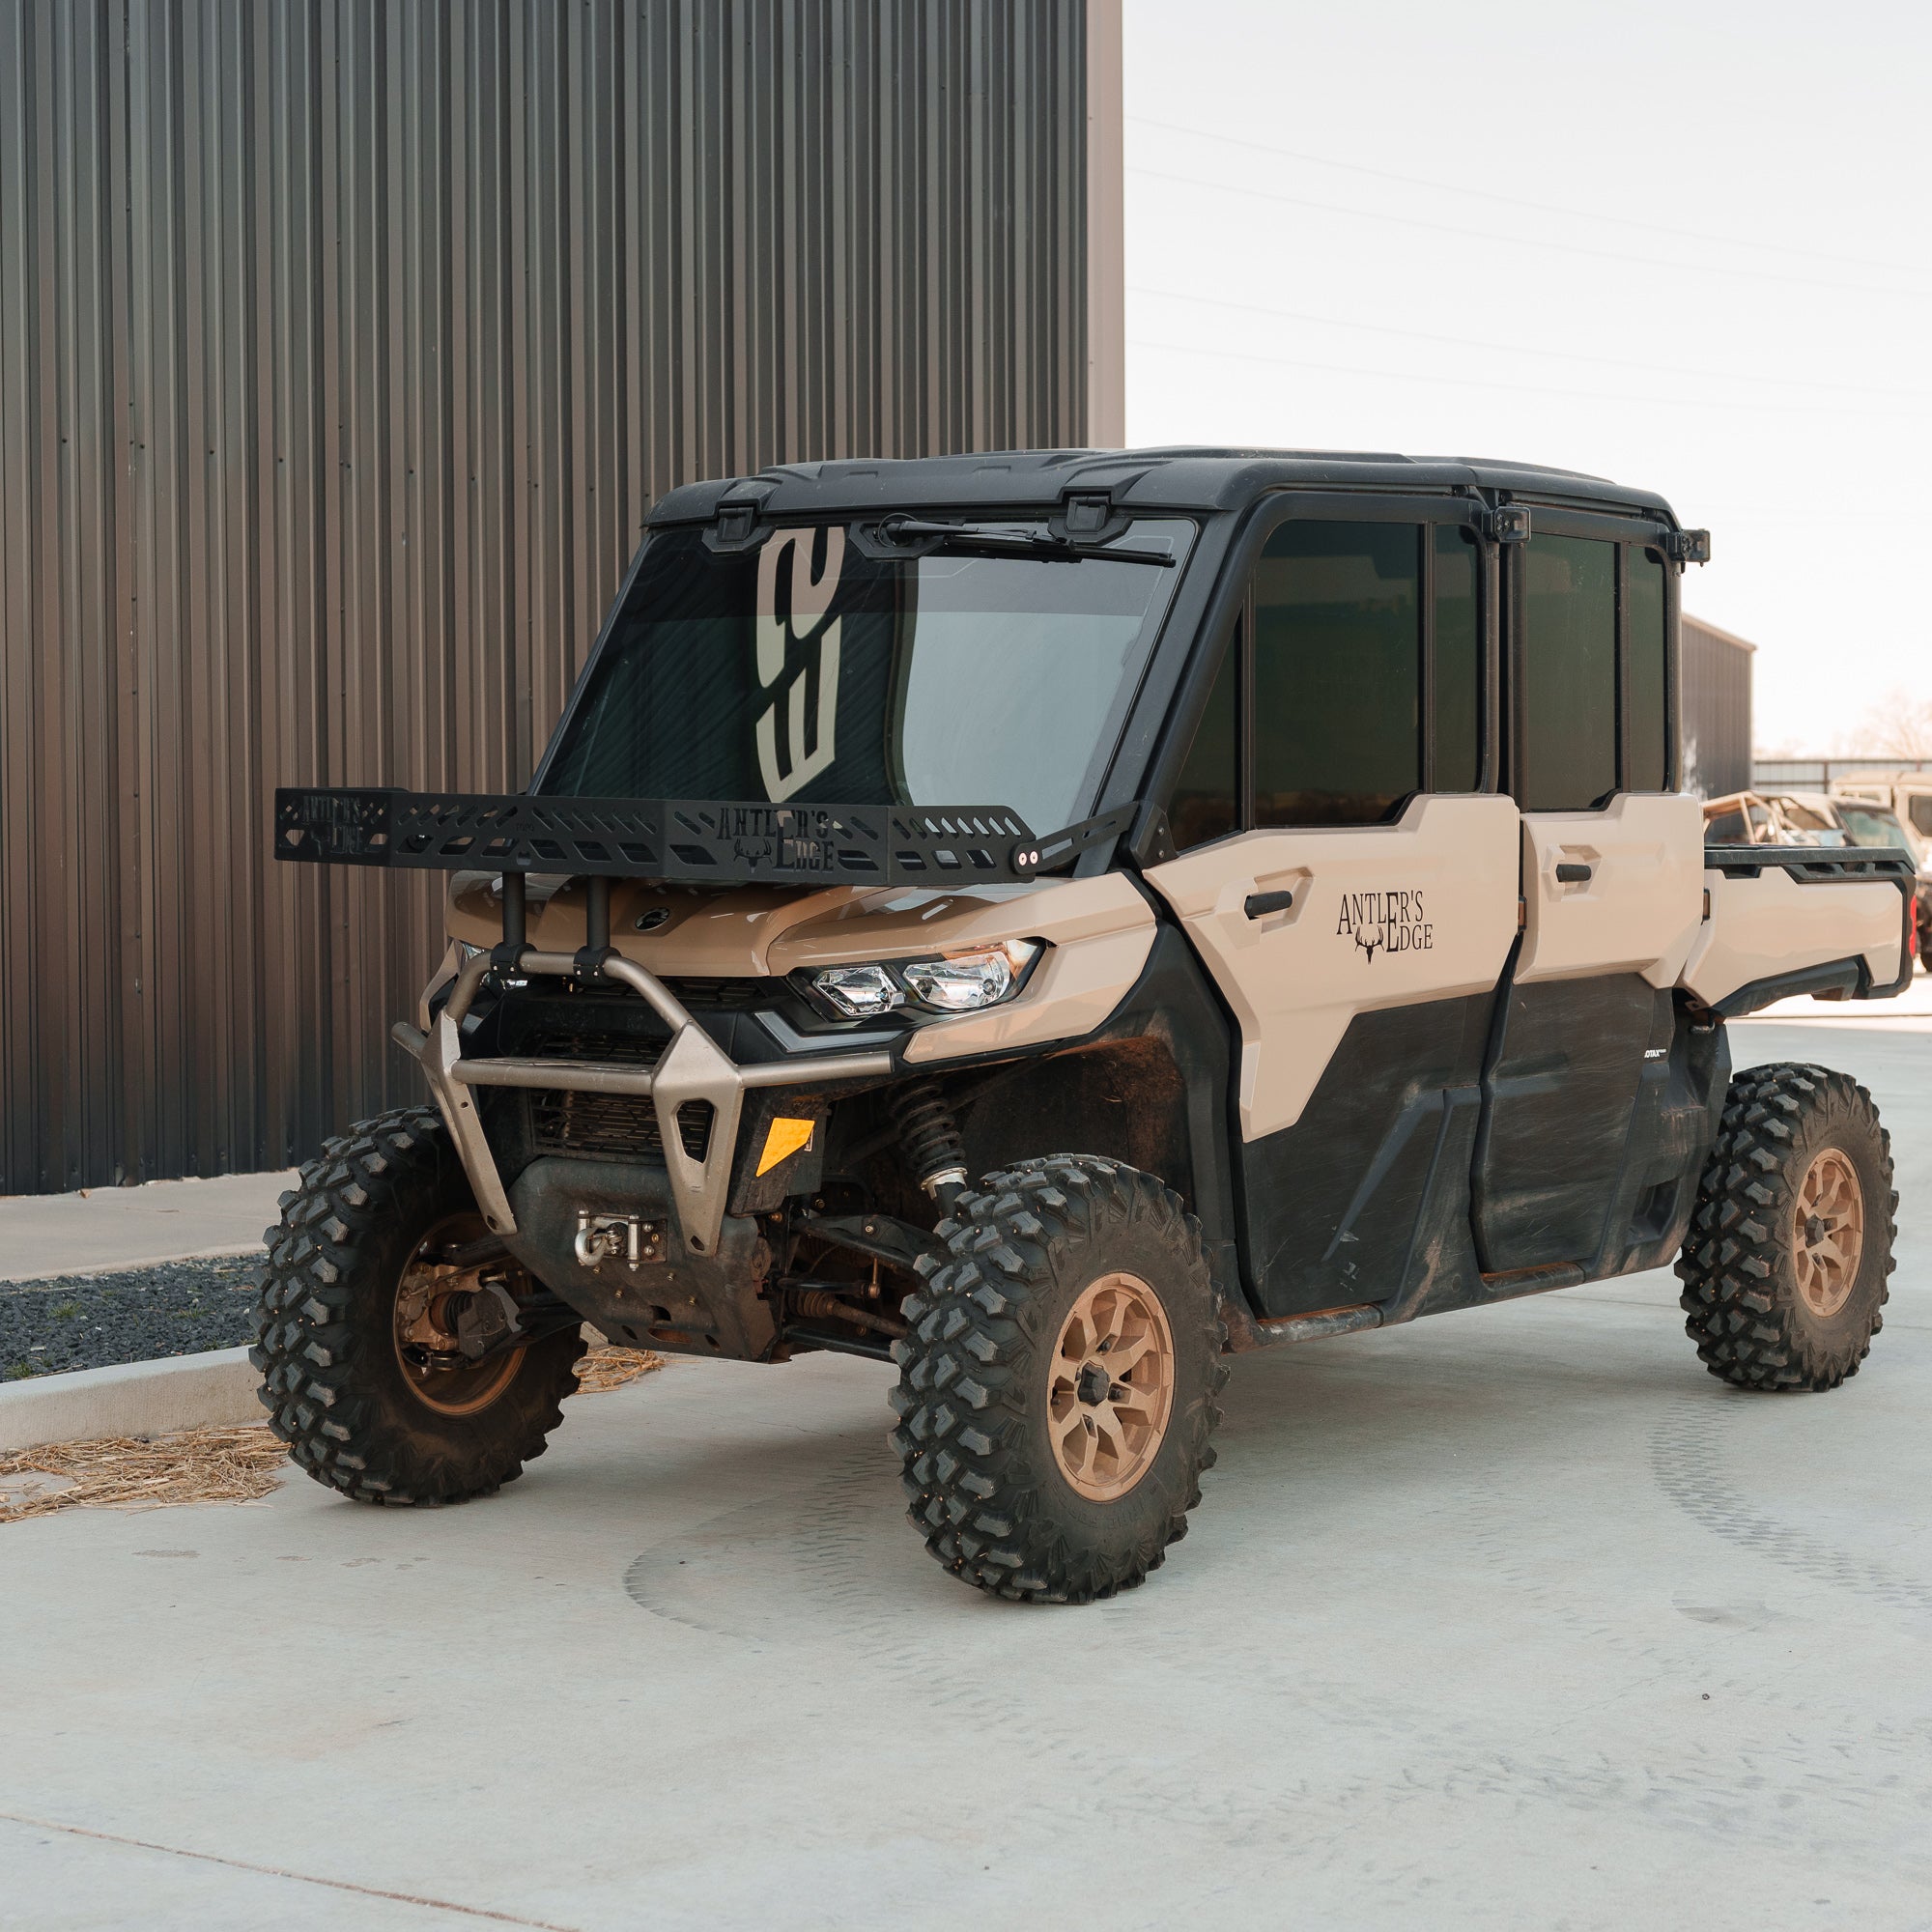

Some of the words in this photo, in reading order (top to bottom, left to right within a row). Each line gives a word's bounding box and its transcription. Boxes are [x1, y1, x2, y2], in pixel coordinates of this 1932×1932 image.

[717, 808, 829, 840] ANTLER'S
[774, 836, 835, 872] EDGE
[1336, 890, 1424, 935] ANTLER'S
[1386, 920, 1434, 952] EDGE
